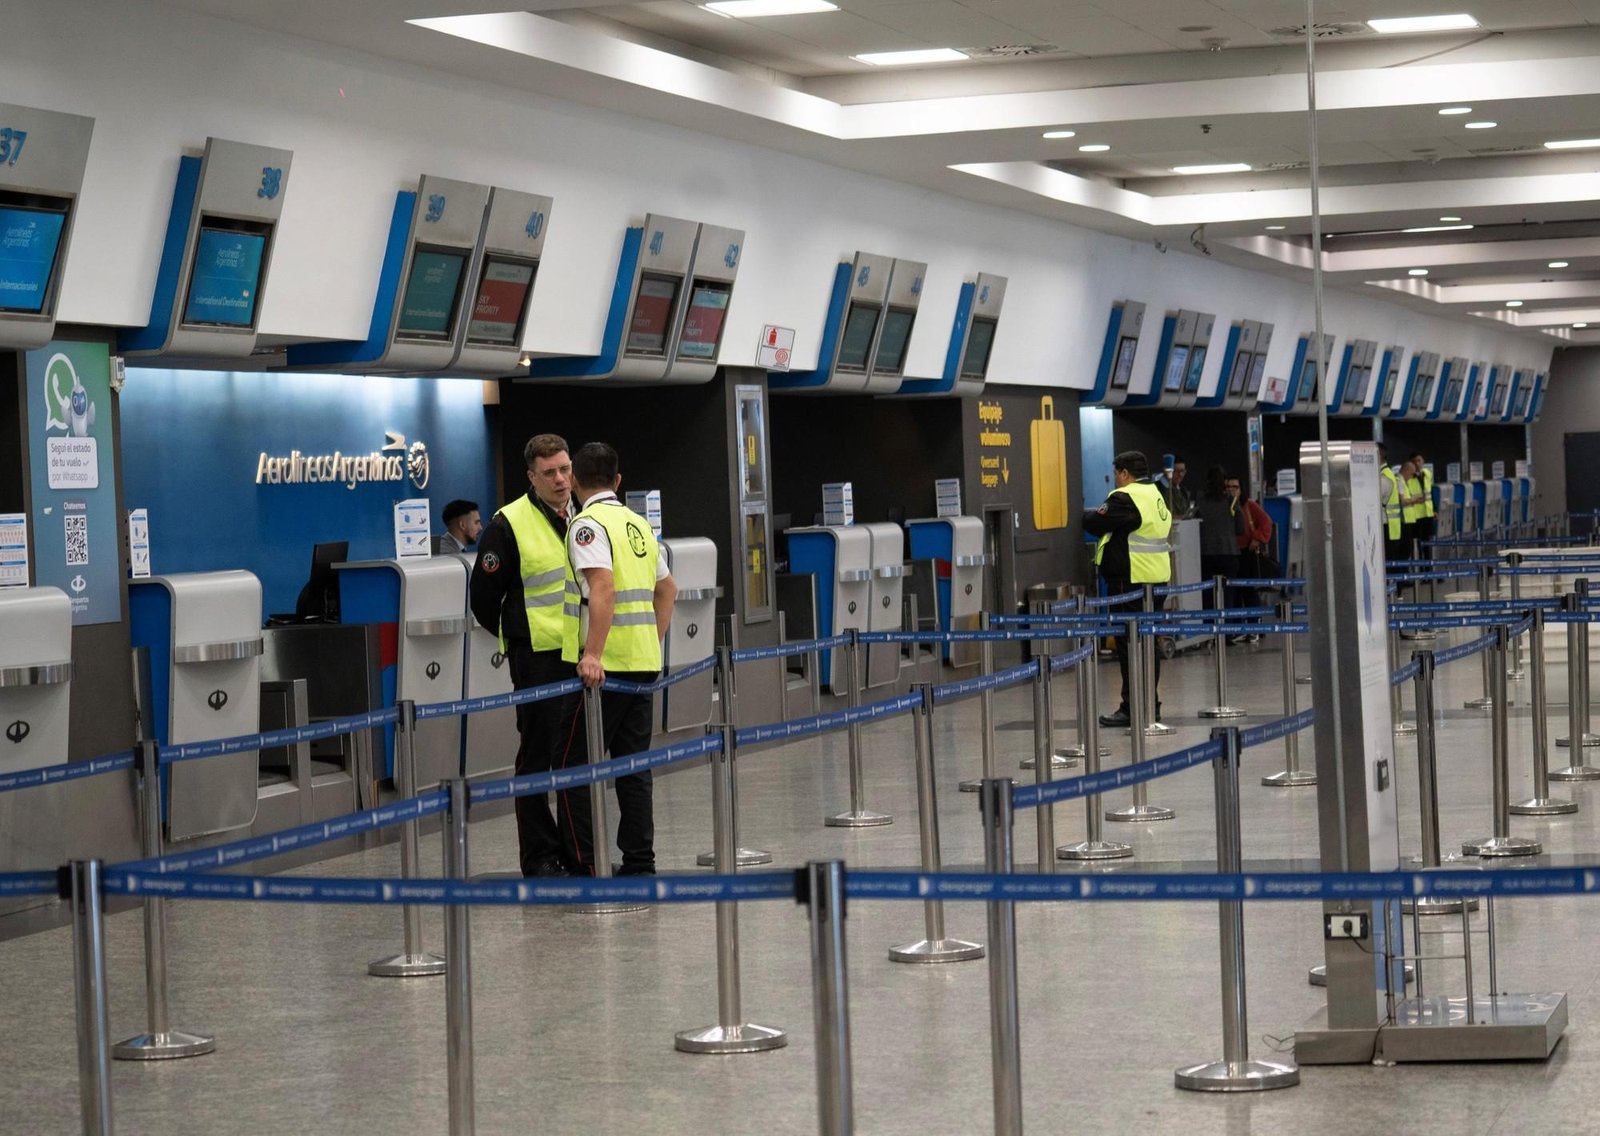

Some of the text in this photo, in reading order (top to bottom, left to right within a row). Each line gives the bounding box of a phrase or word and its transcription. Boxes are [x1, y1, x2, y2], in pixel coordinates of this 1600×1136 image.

[0, 128, 27, 166] 37
[257, 167, 282, 199] 38
[525, 211, 544, 240] 40
[67, 444, 72, 452] el
[73, 442, 91, 453] estado
[52, 457, 81, 467] de tu vuelo
[52, 473, 61, 484] por
